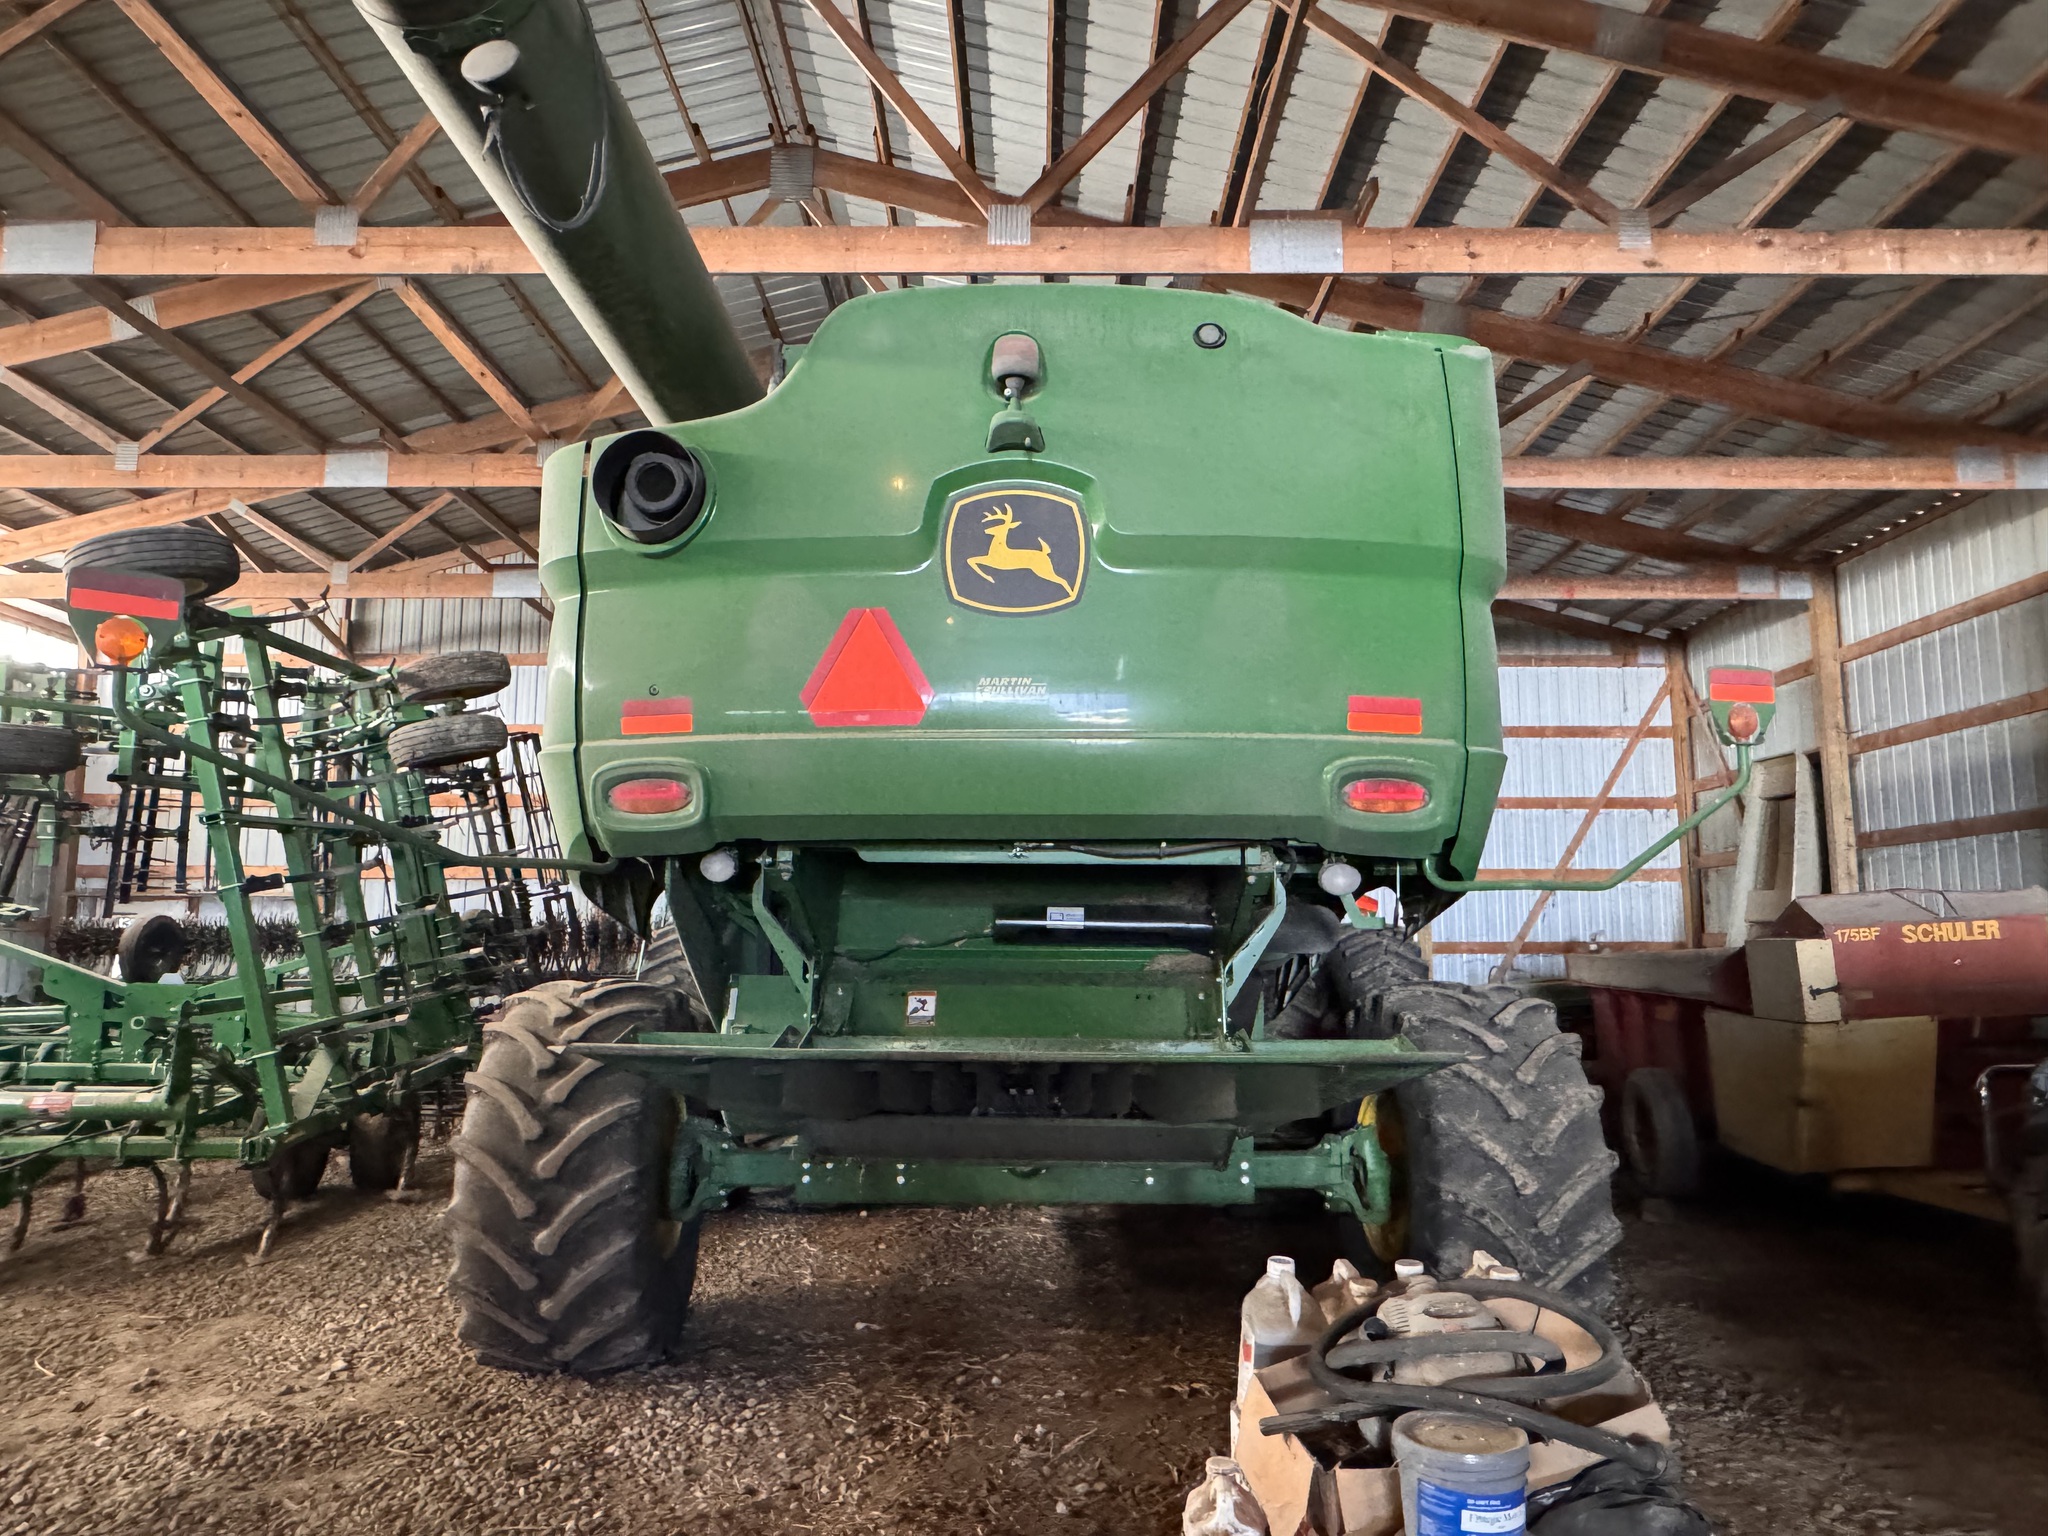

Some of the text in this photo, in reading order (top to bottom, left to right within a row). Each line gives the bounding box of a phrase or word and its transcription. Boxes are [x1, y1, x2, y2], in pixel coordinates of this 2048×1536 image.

[978, 677, 1032, 686] MARTIN
[1834, 920, 2000, 943] 175BF SCHULER
